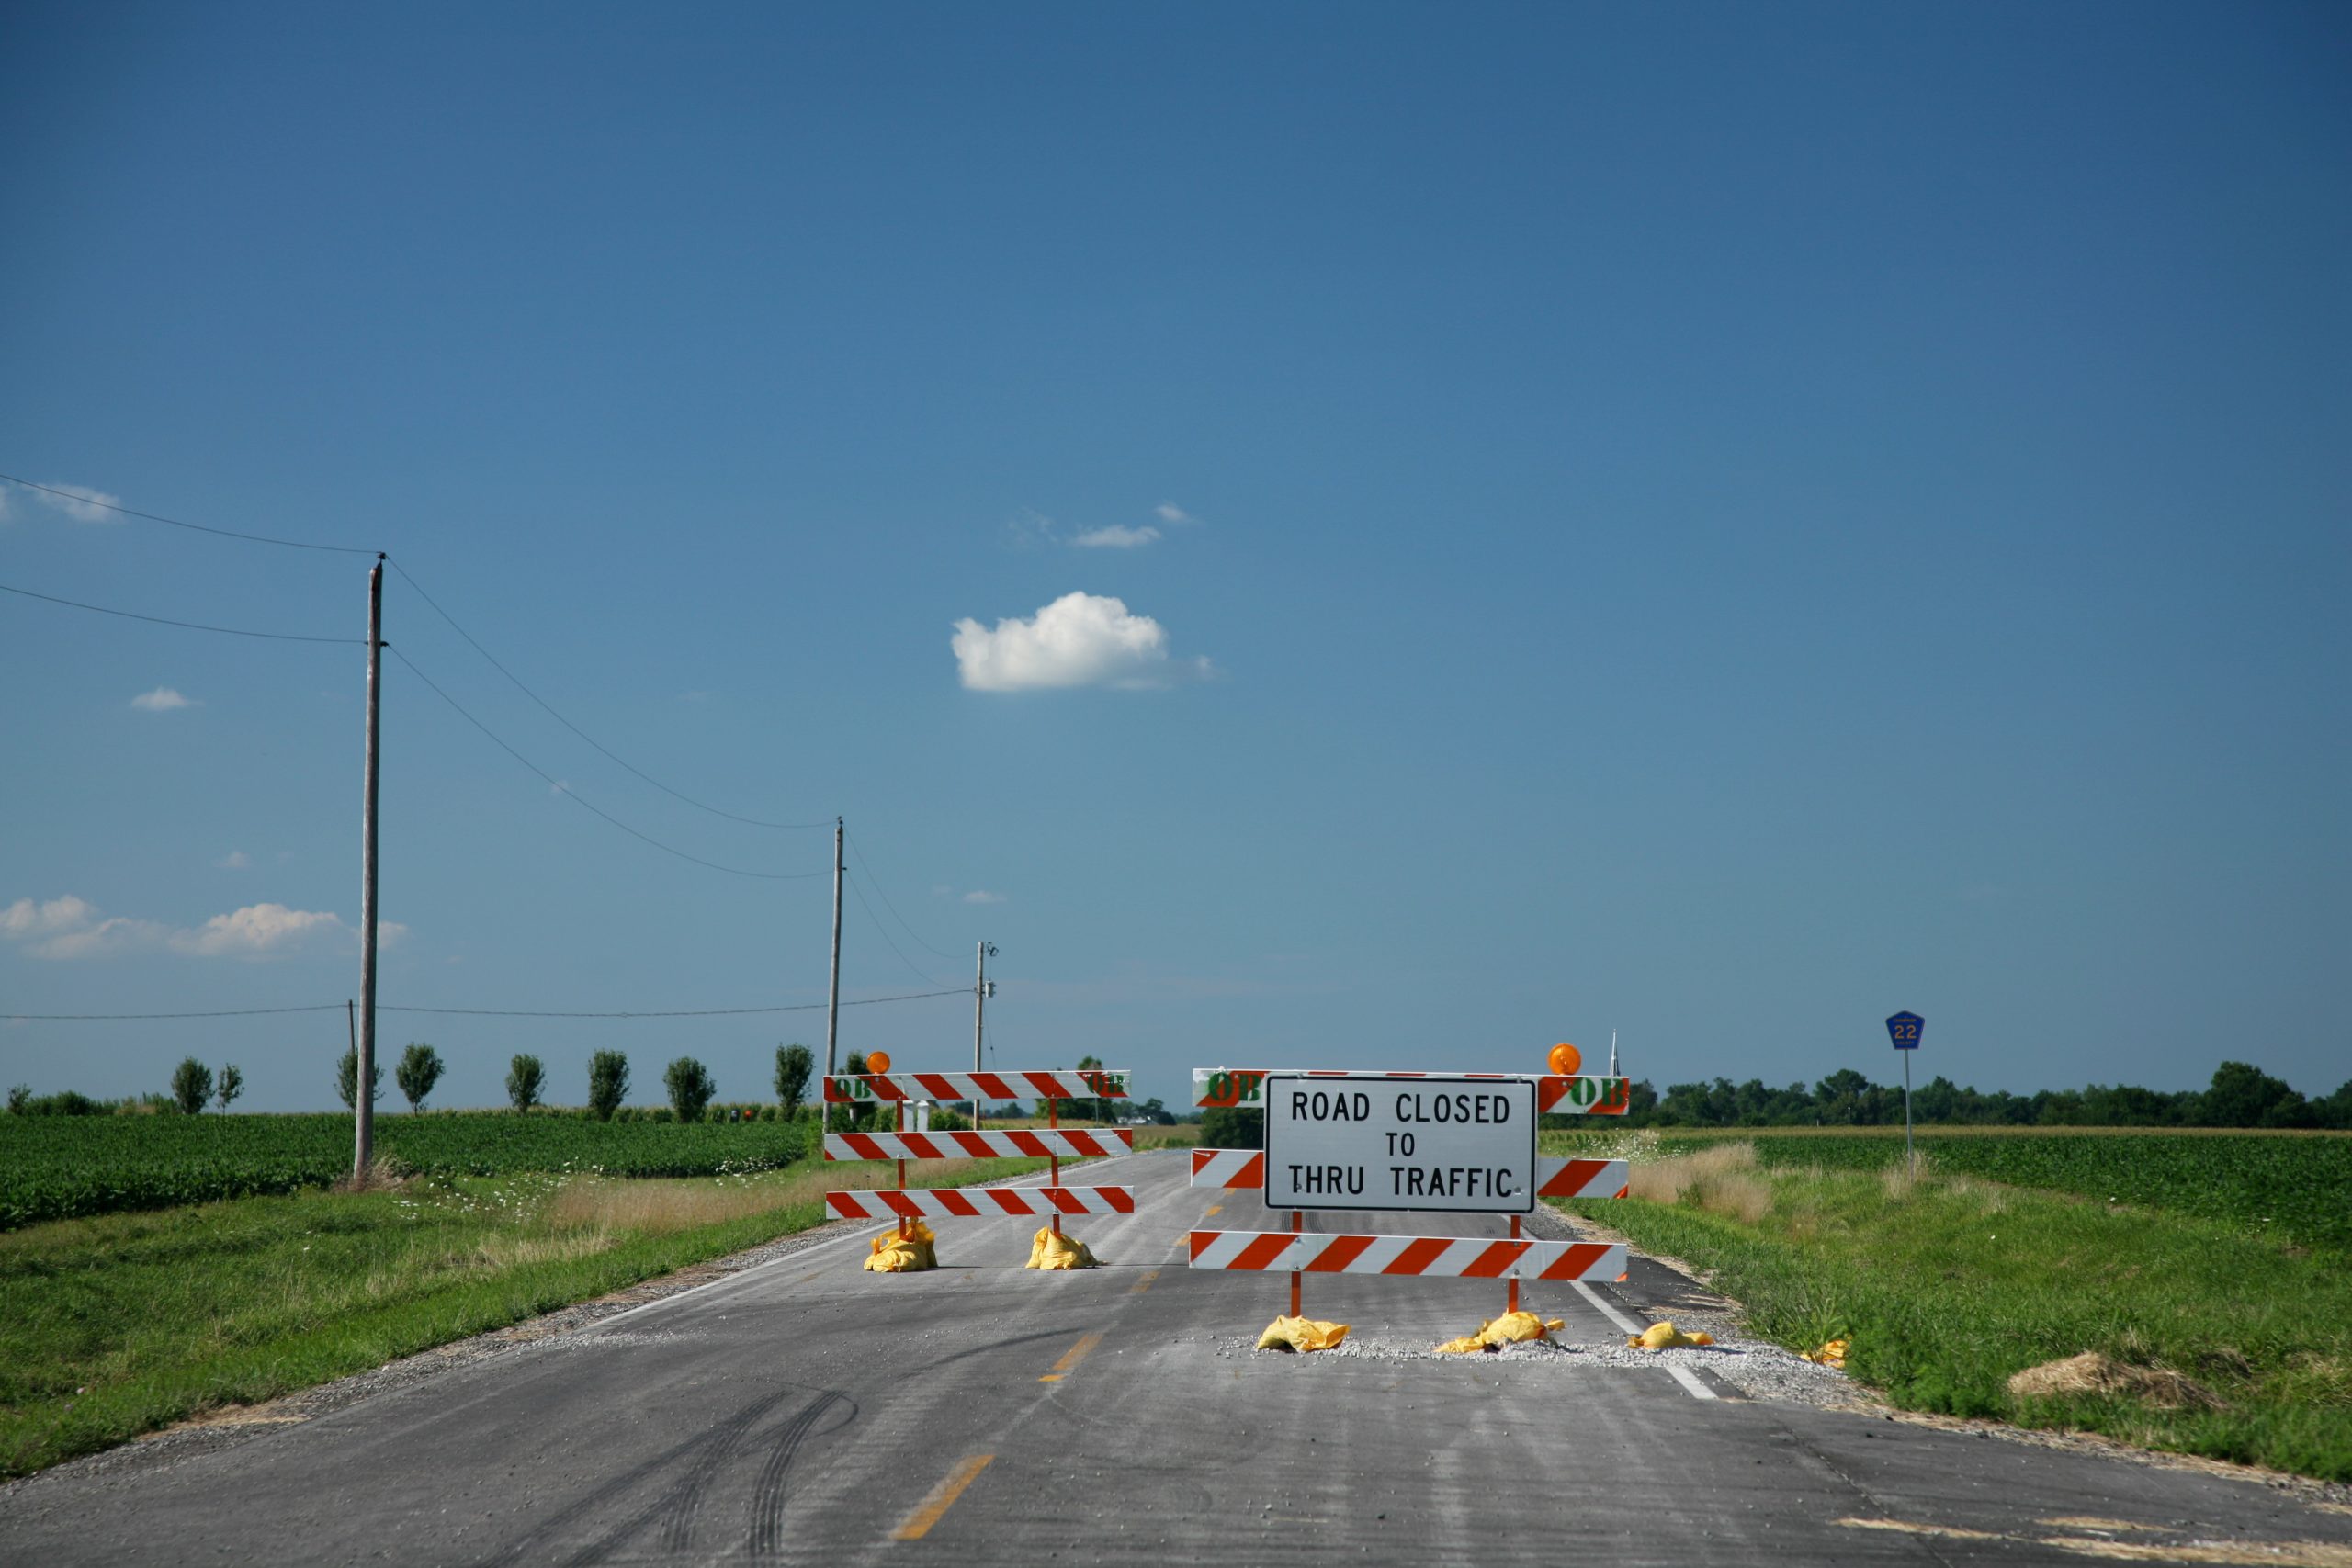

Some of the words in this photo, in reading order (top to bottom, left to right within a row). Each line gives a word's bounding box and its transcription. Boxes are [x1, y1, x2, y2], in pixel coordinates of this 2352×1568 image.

[1894, 1024, 1917, 1039] 22
[1208, 1072, 1261, 1101] OB
[1570, 1077, 1624, 1106] OB
[1292, 1091, 1370, 1122] ROAD
[1396, 1093, 1510, 1123] CLOSED
[1385, 1132, 1415, 1156] TO
[1288, 1165, 1364, 1195] THRU
[1390, 1167, 1512, 1198] TRAFFIC
